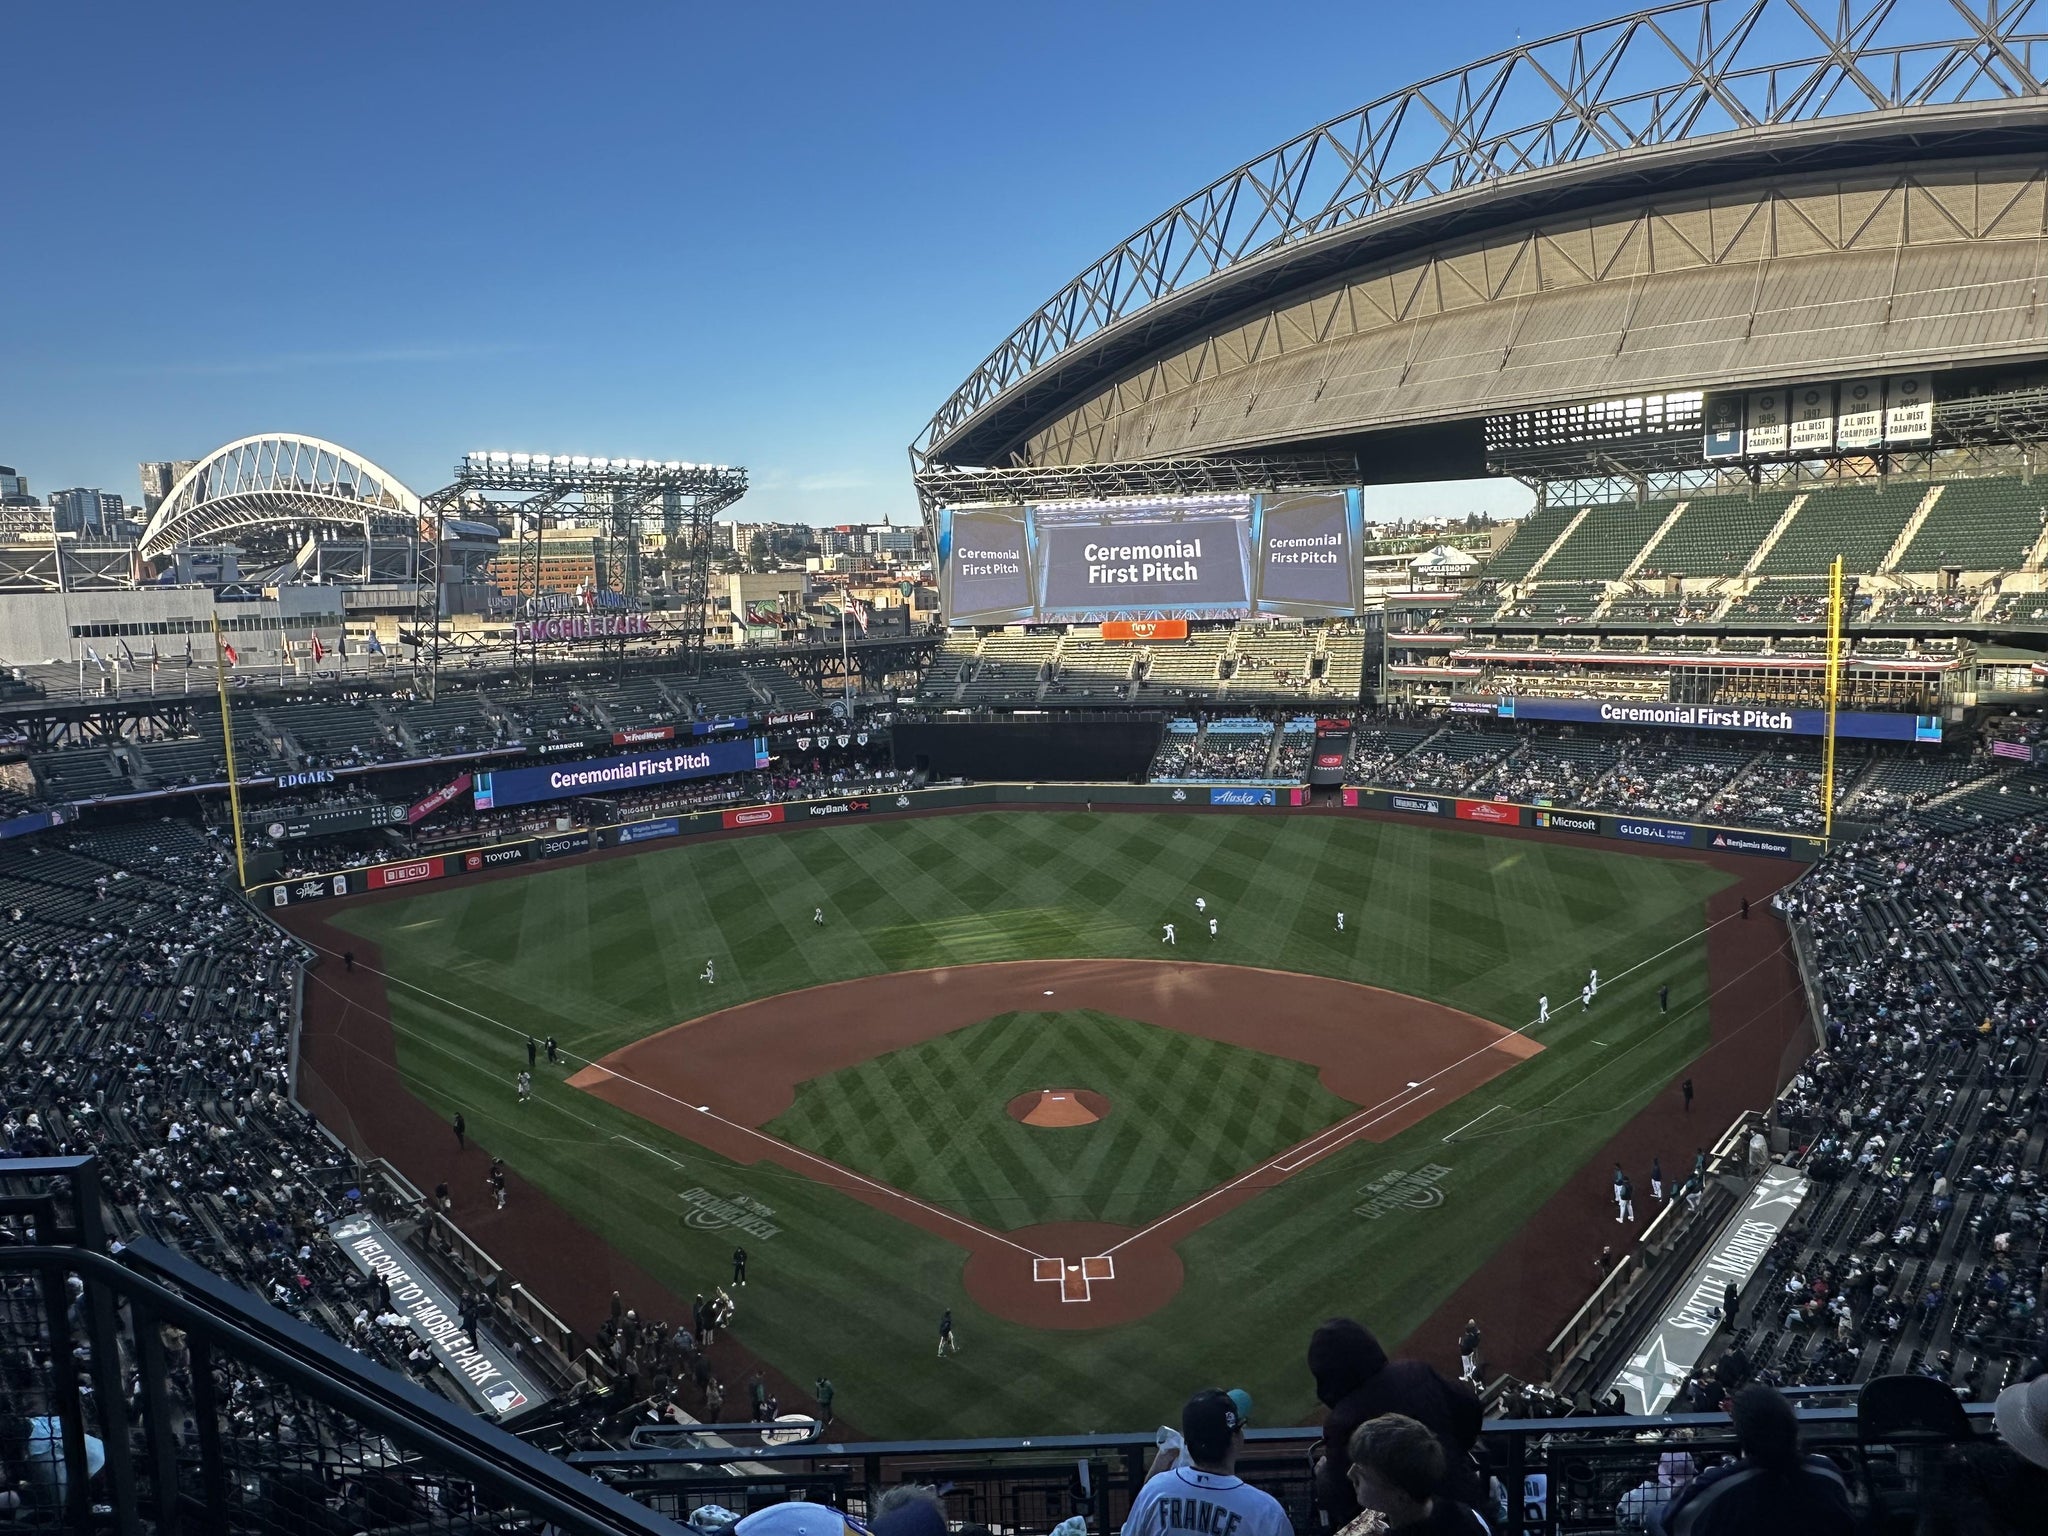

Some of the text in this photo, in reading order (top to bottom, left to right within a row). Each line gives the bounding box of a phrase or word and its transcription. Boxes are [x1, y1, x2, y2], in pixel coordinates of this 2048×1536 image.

[1758, 413, 1776, 424] 1995
[1856, 416, 1875, 426] WEST
[1906, 411, 1924, 421] WEST
[1840, 428, 1878, 439] CHAMPIONS
[1889, 423, 1927, 435] CHAMPIONS
[1749, 437, 1784, 448] CHAMPIONS
[1793, 432, 1829, 443] CHAMPIONS
[1269, 532, 1342, 549] Ceremonial
[958, 547, 1020, 560] Ceremonial
[1084, 538, 1202, 562] Ceremonial
[1271, 550, 1337, 564] First Pitch
[962, 563, 1019, 576] First Pitch
[1088, 561, 1198, 584] First Pitch
[1418, 564, 1471, 573] MUCKLESHOOT
[514, 612, 652, 644] T-MOBILE PARK
[1600, 703, 1793, 730] Ceremonial First Pitch
[548, 741, 584, 751] STARBUCKS
[551, 752, 710, 788] Ceremonial First Pitch
[278, 770, 335, 788] EDGARS
[1213, 789, 1255, 805] Alaska
[810, 803, 849, 816] KeyBank
[1552, 816, 1596, 831] Microsoft
[1620, 824, 1665, 839] GLOBAL
[1726, 838, 1787, 853] Benjamin Moore
[485, 849, 521, 863] TOYOTA
[387, 866, 427, 881] BECU
[1706, 1218, 1778, 1279] MARINERS
[351, 1235, 503, 1387] WELCOME TO T-MOBILE PARK
[1157, 1496, 1242, 1536] FRANCE
